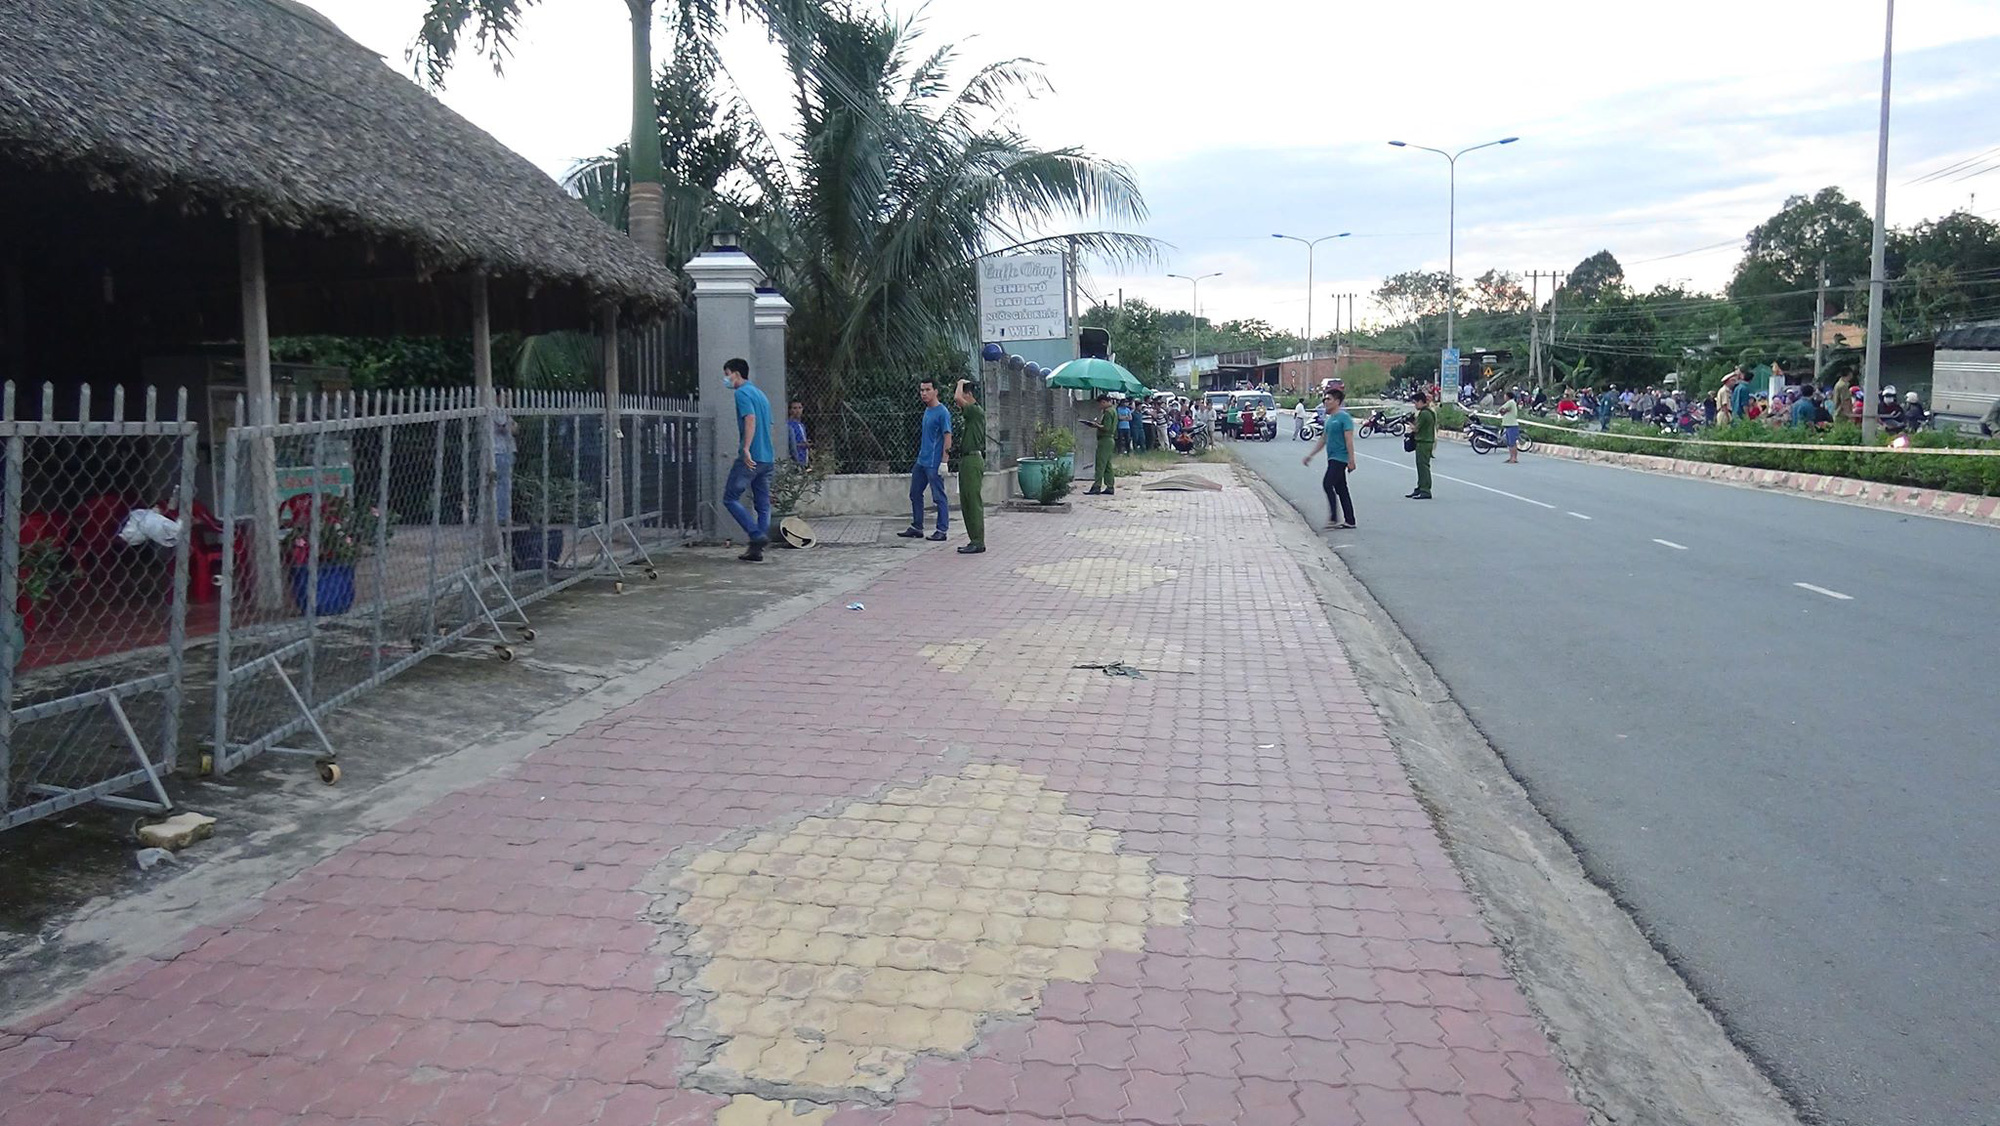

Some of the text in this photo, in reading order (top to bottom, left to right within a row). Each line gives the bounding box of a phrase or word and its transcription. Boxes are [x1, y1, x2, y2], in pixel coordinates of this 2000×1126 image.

[994, 283, 1025, 294] SINH
[995, 294, 1045, 307] RAU MÁ
[1009, 325, 1039, 337] WIFI
